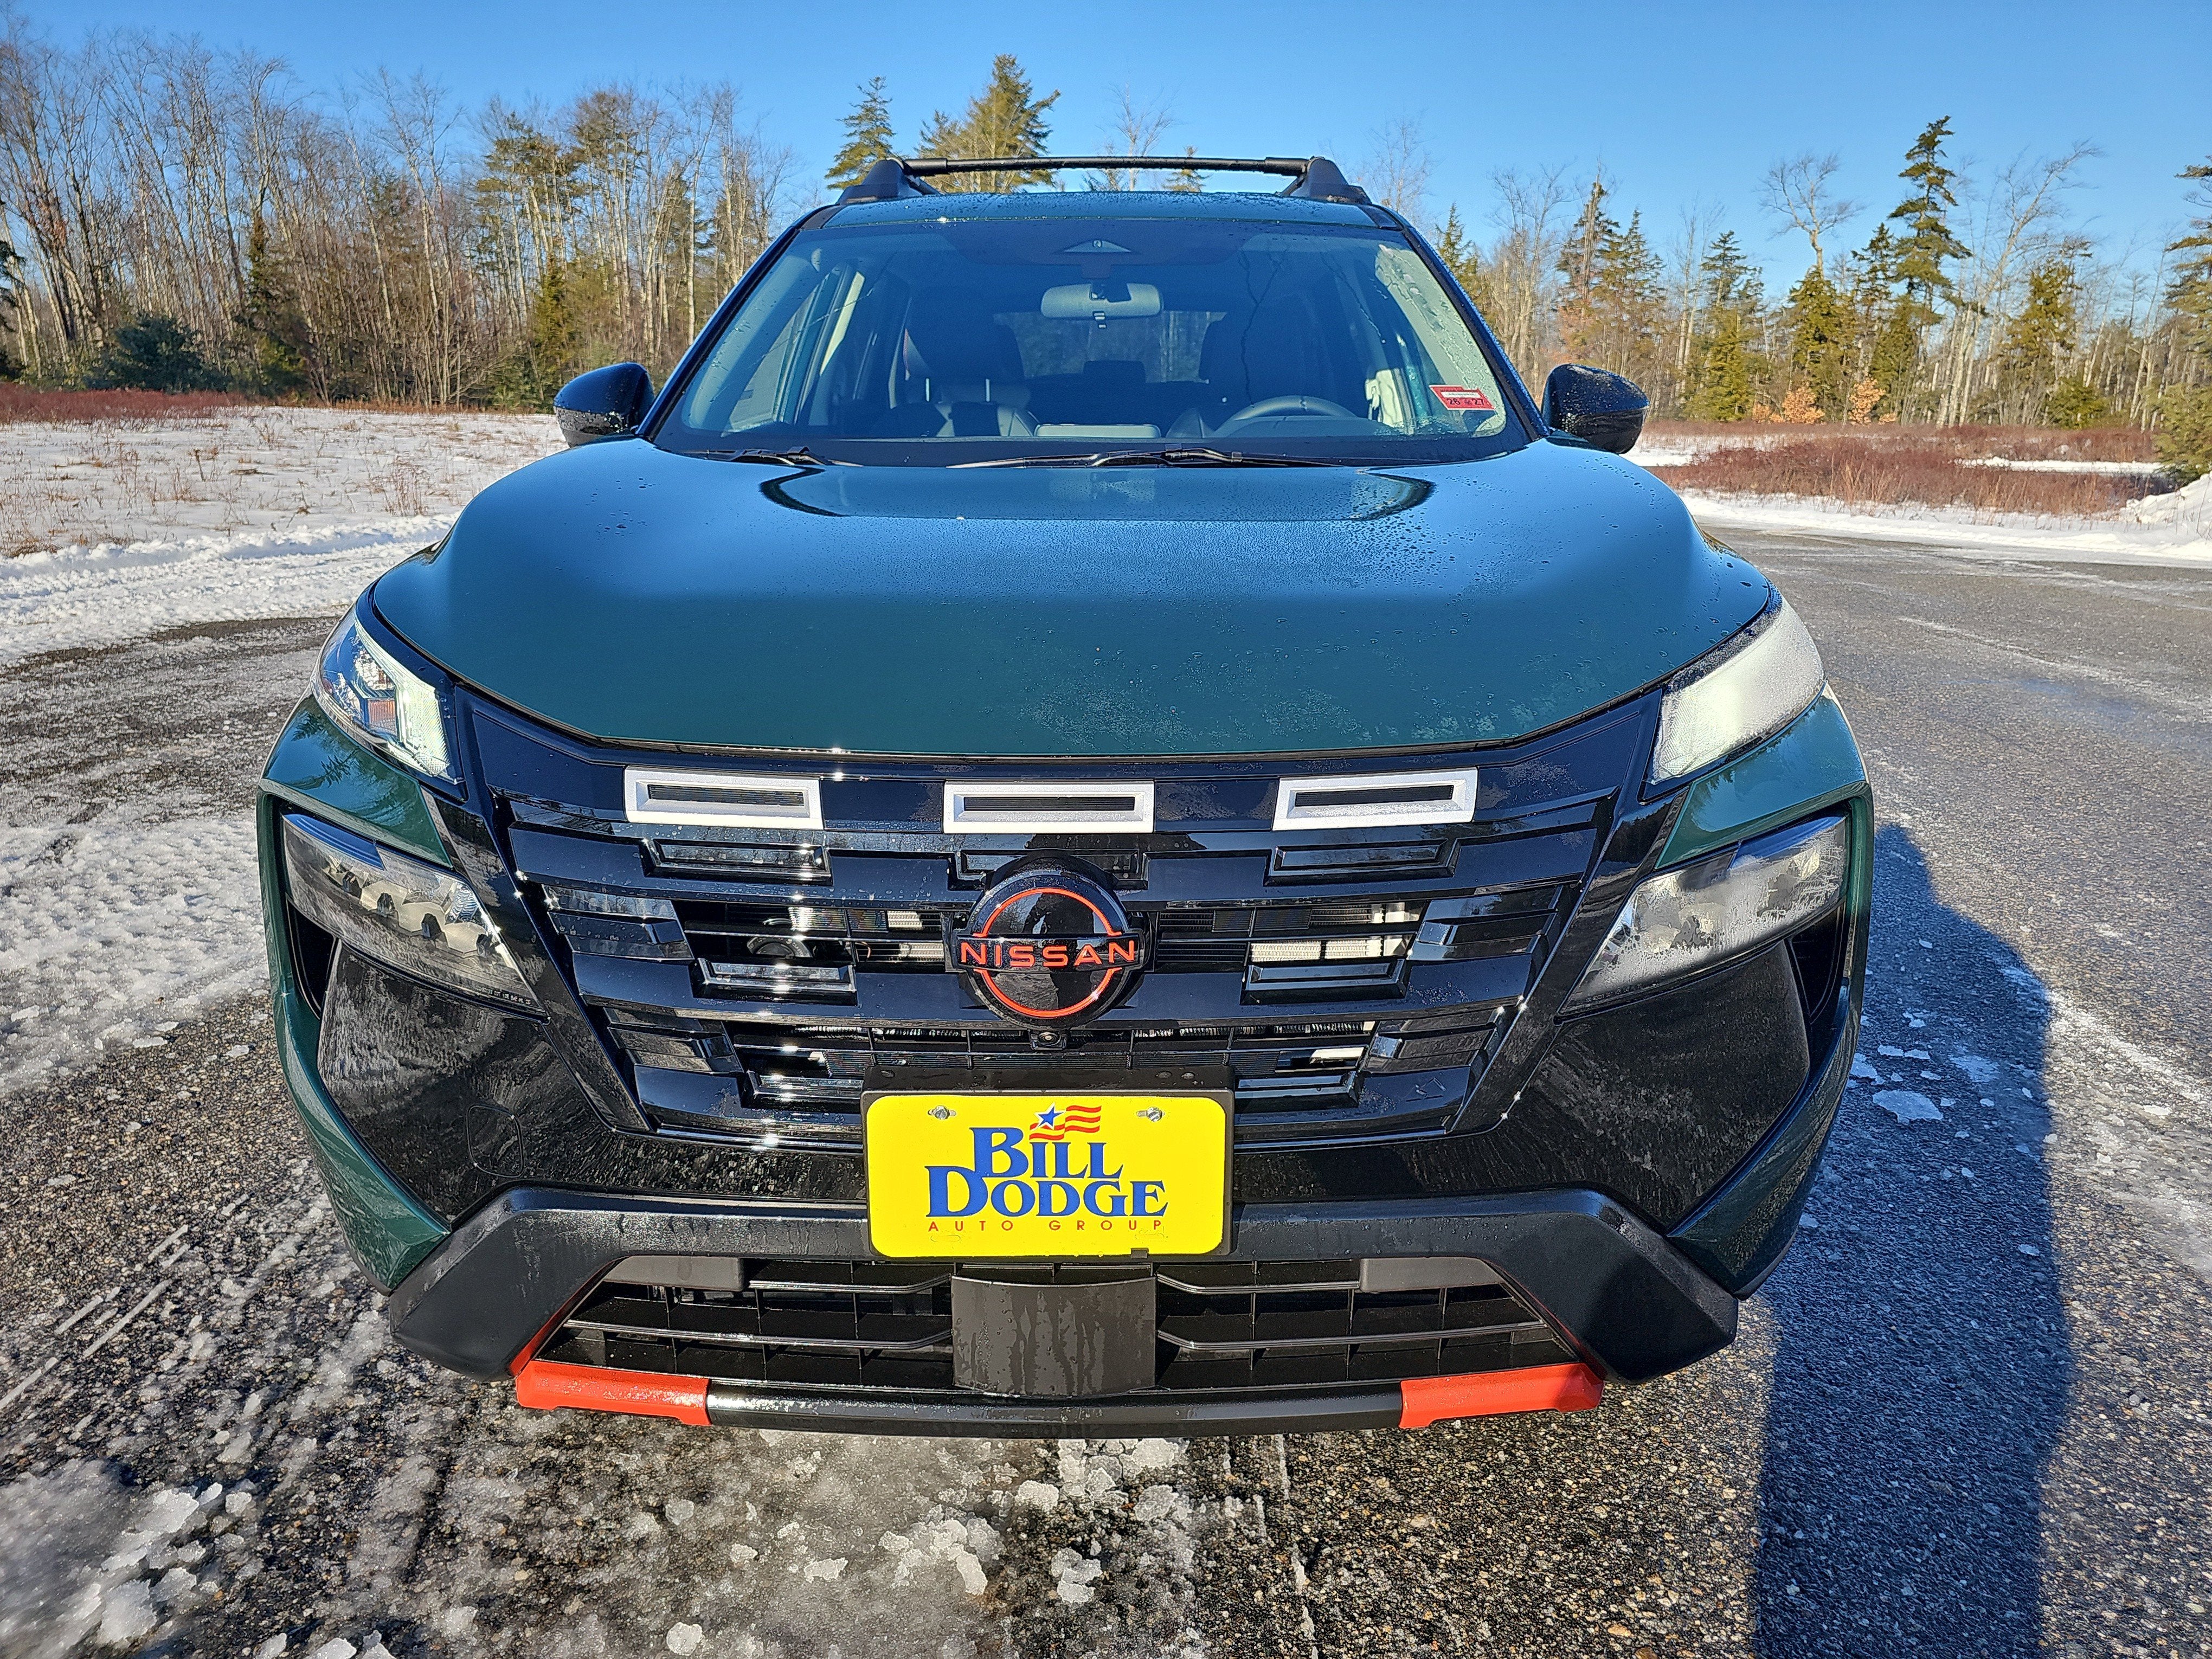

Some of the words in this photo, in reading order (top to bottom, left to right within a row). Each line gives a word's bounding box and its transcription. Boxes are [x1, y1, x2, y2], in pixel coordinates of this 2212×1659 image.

[961, 940, 1135, 967] NISSAN
[969, 1127, 1123, 1178] BILL
[924, 1166, 1168, 1217] DODGE
[928, 1220, 1014, 1231] AUTO
[1048, 1220, 1162, 1231] GROUP
